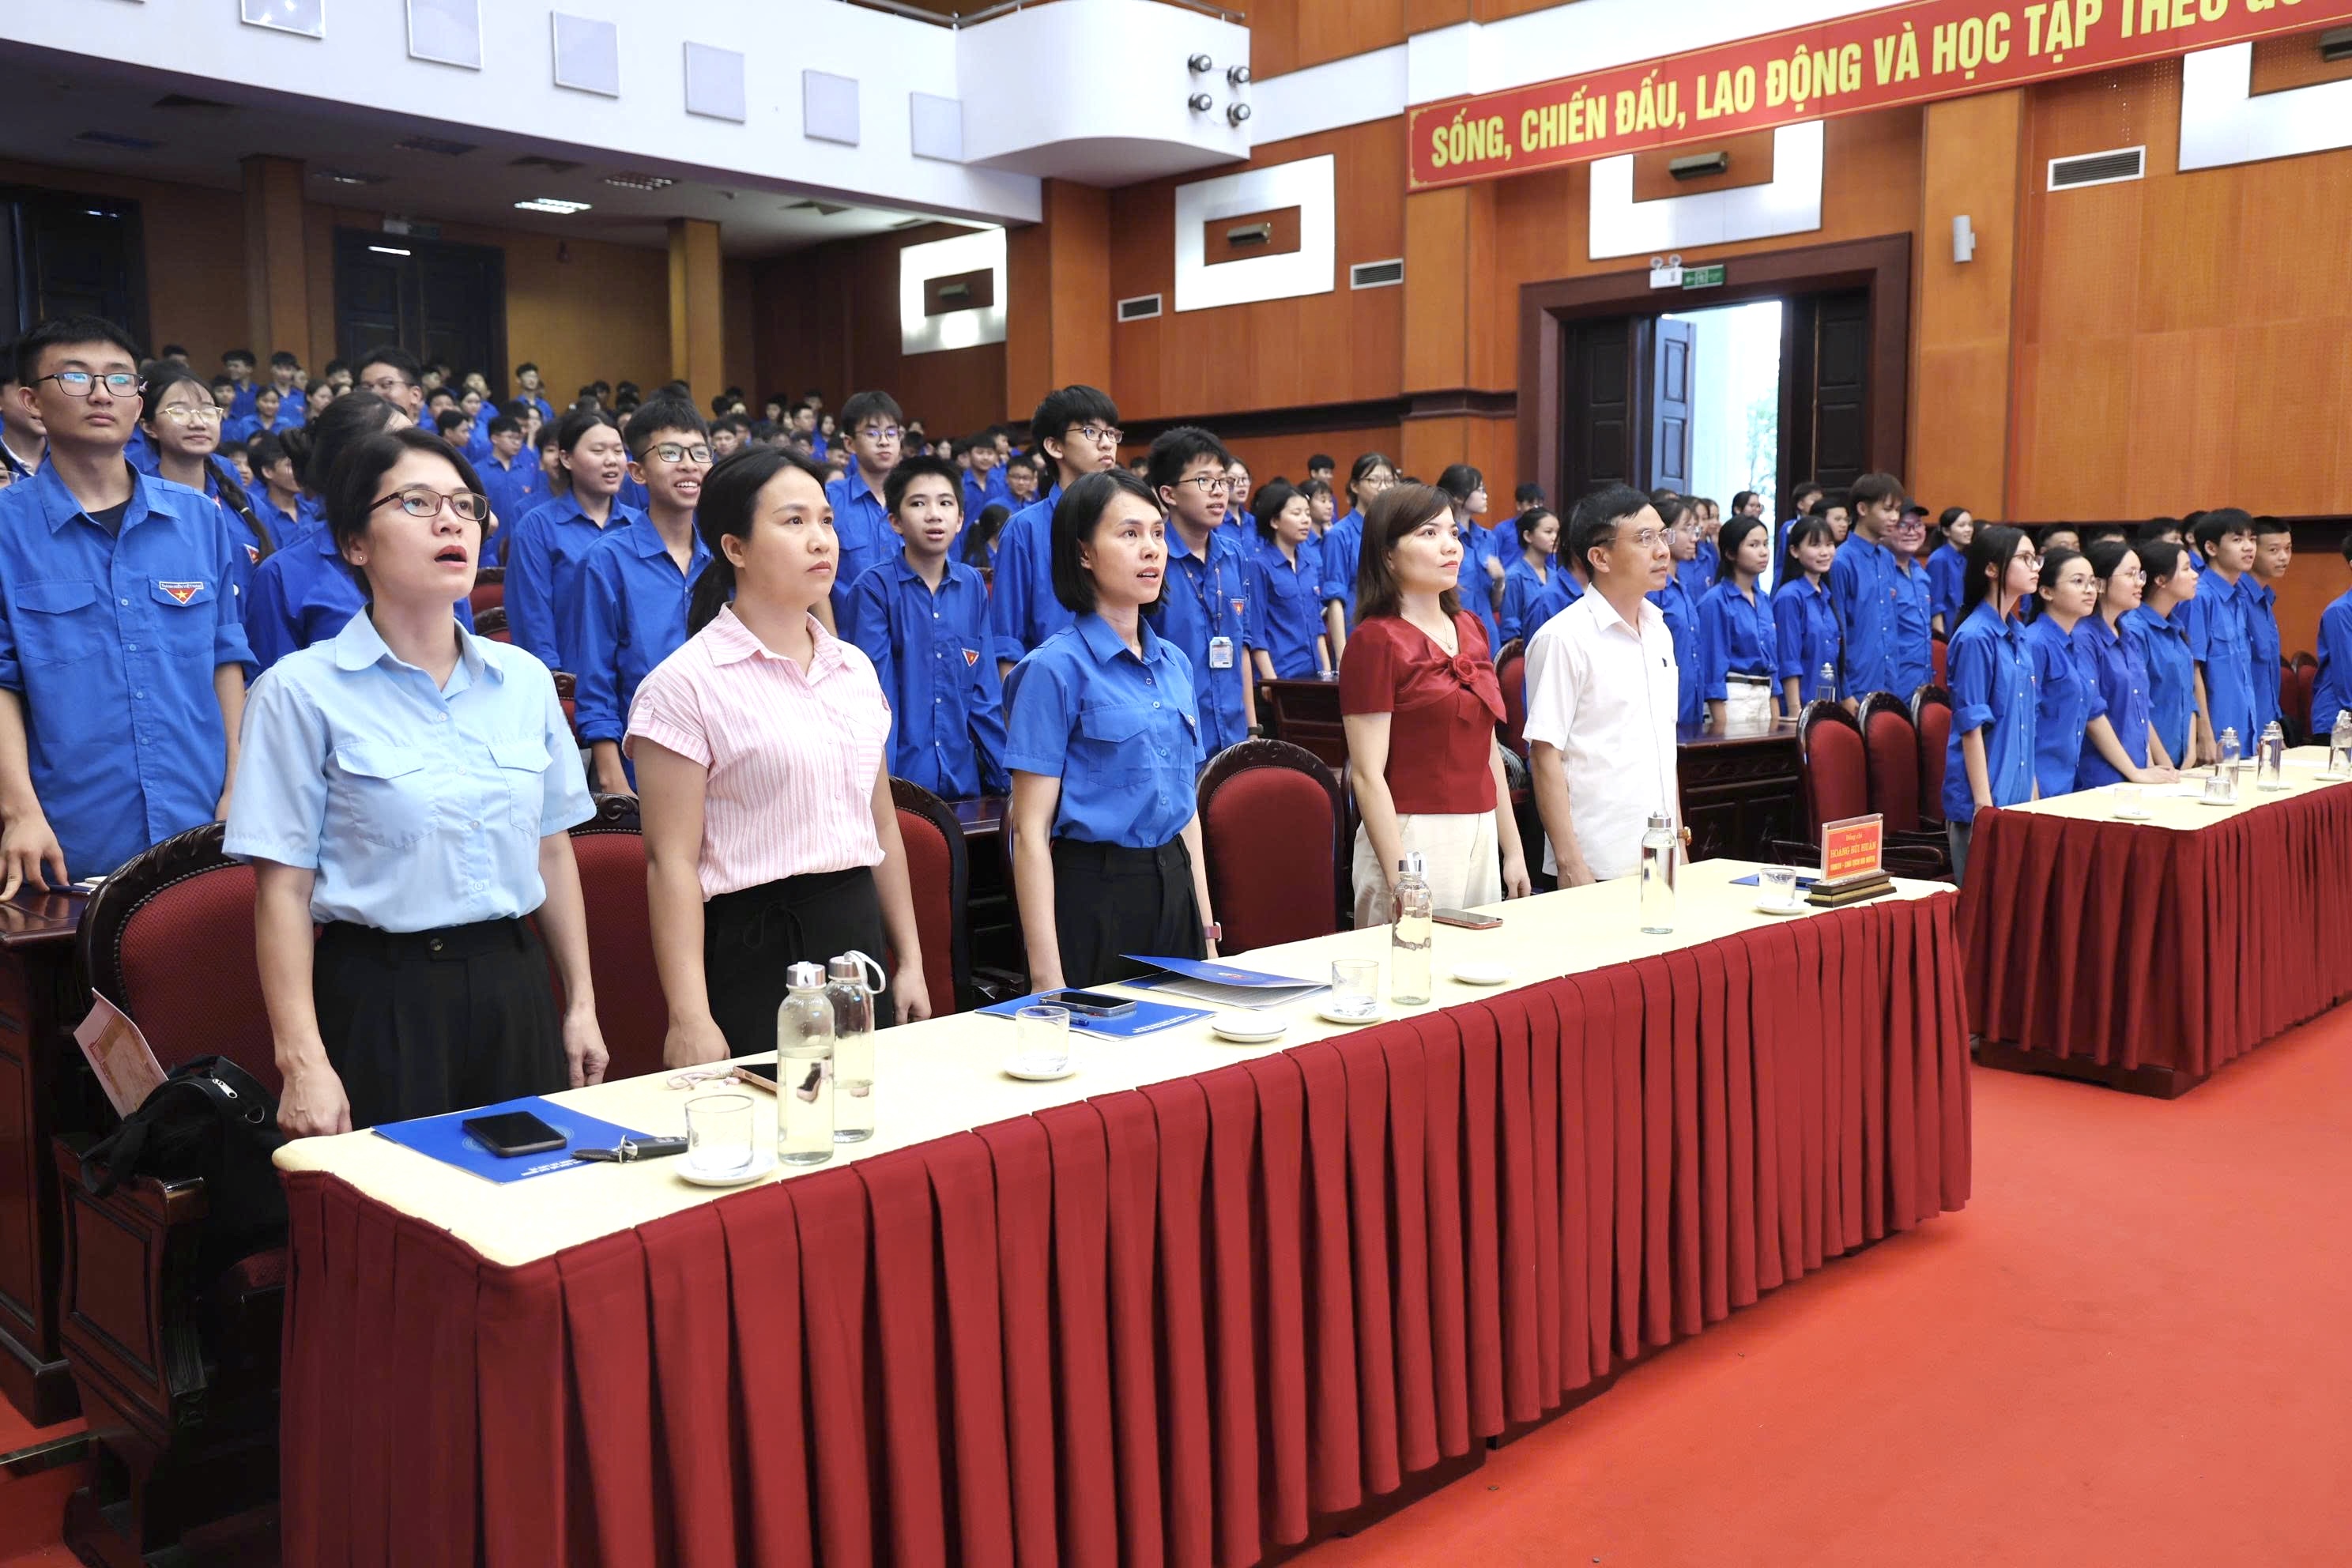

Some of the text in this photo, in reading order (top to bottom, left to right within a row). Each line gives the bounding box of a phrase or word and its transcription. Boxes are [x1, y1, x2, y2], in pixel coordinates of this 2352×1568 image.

[1431, 107, 1512, 168] SỐNG,
[1521, 85, 1607, 152] CHIẾN
[1615, 69, 1686, 136] ĐẤU,
[1696, 65, 1756, 121] LAO
[1765, 43, 1862, 112] ĐỘNG
[1873, 21, 1920, 86] VÀ
[1932, 11, 2011, 80] HỌC
